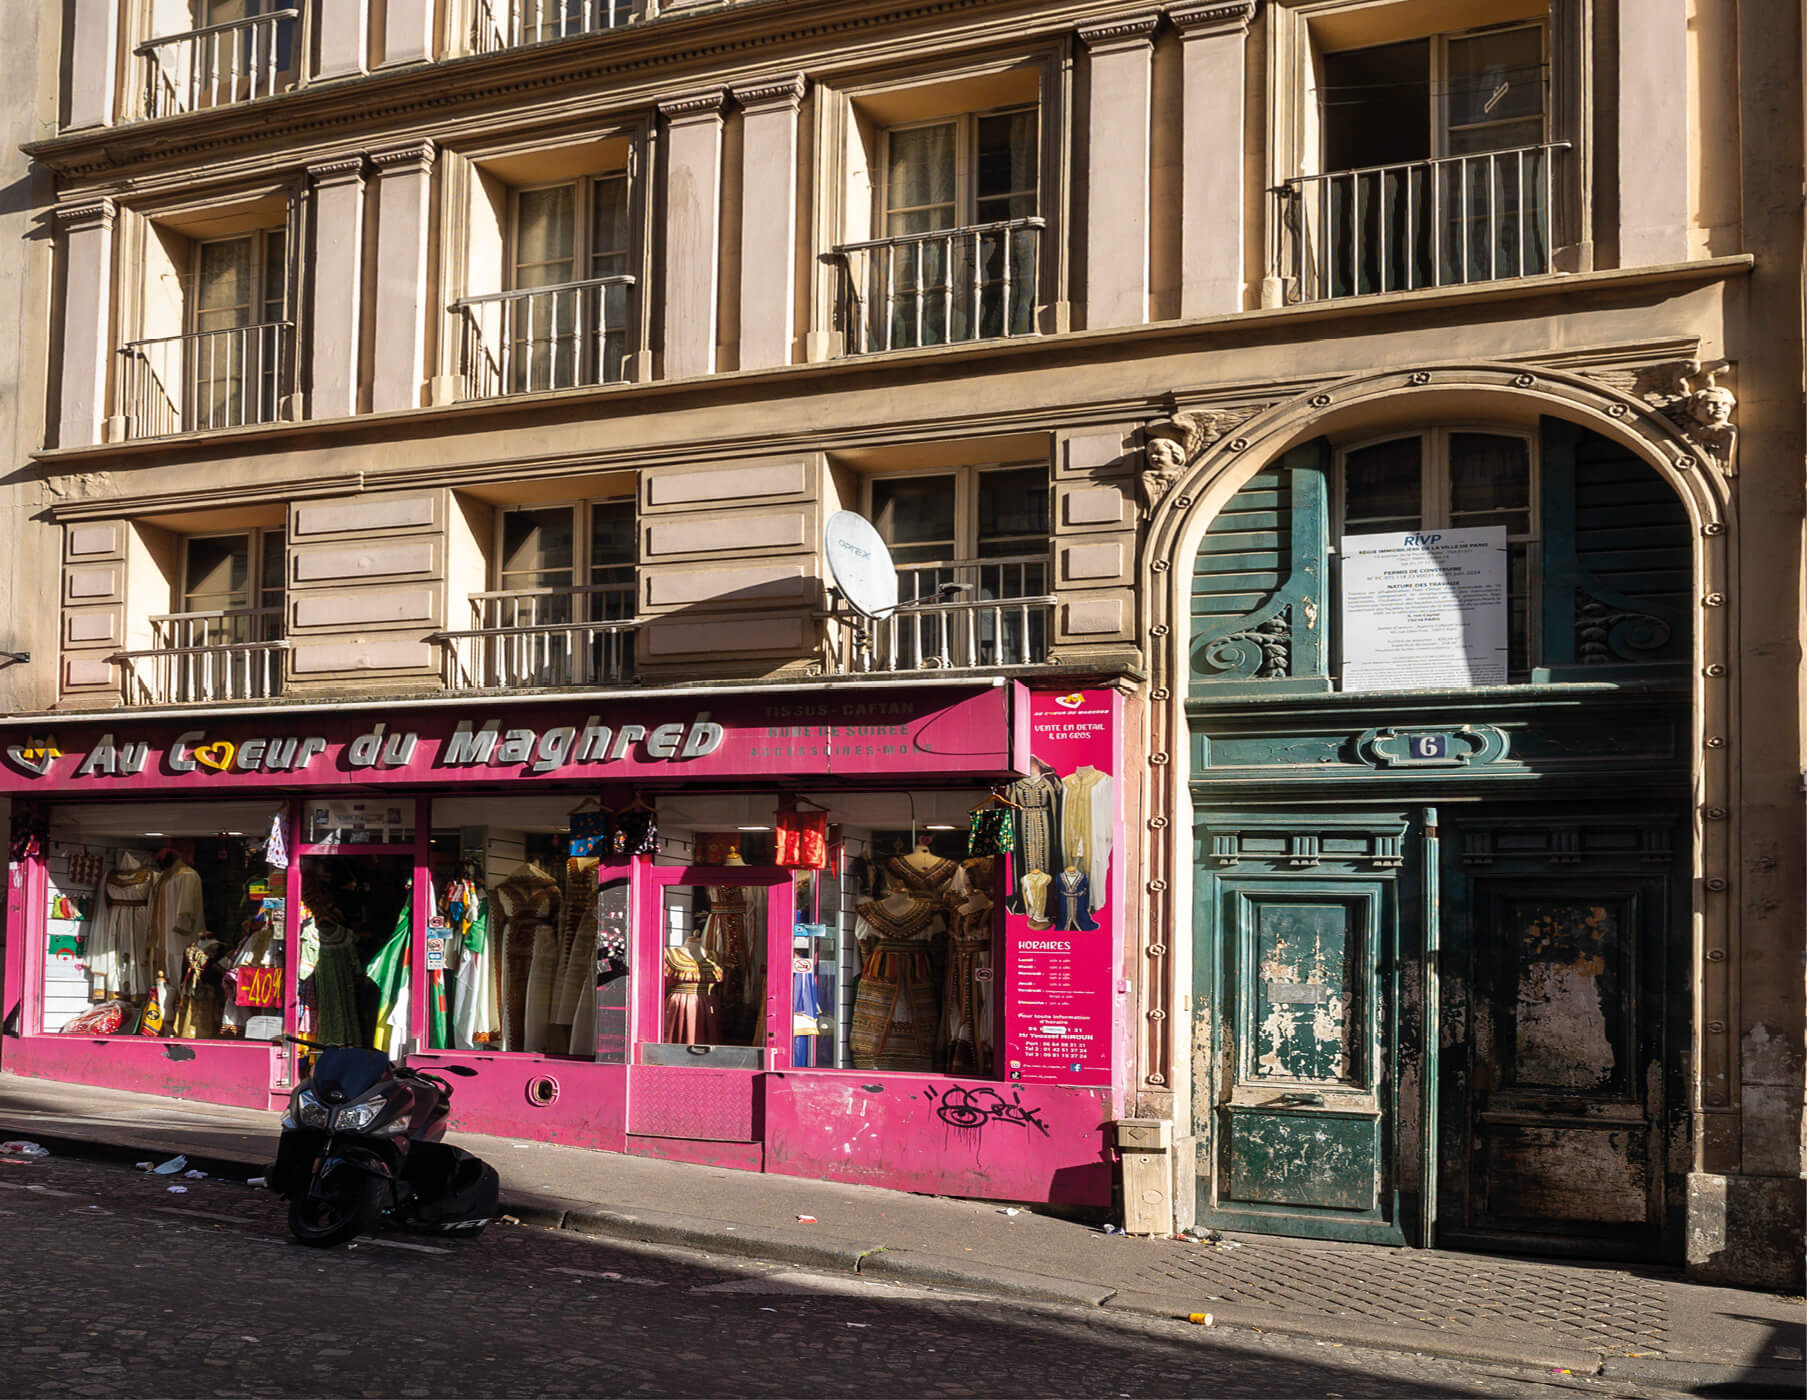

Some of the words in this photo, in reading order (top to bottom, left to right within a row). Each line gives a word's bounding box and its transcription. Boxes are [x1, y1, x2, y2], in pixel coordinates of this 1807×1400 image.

[348, 722, 418, 767] du
[1419, 736, 1438, 757] 6
[1017, 940, 1071, 951] HORAIRES
